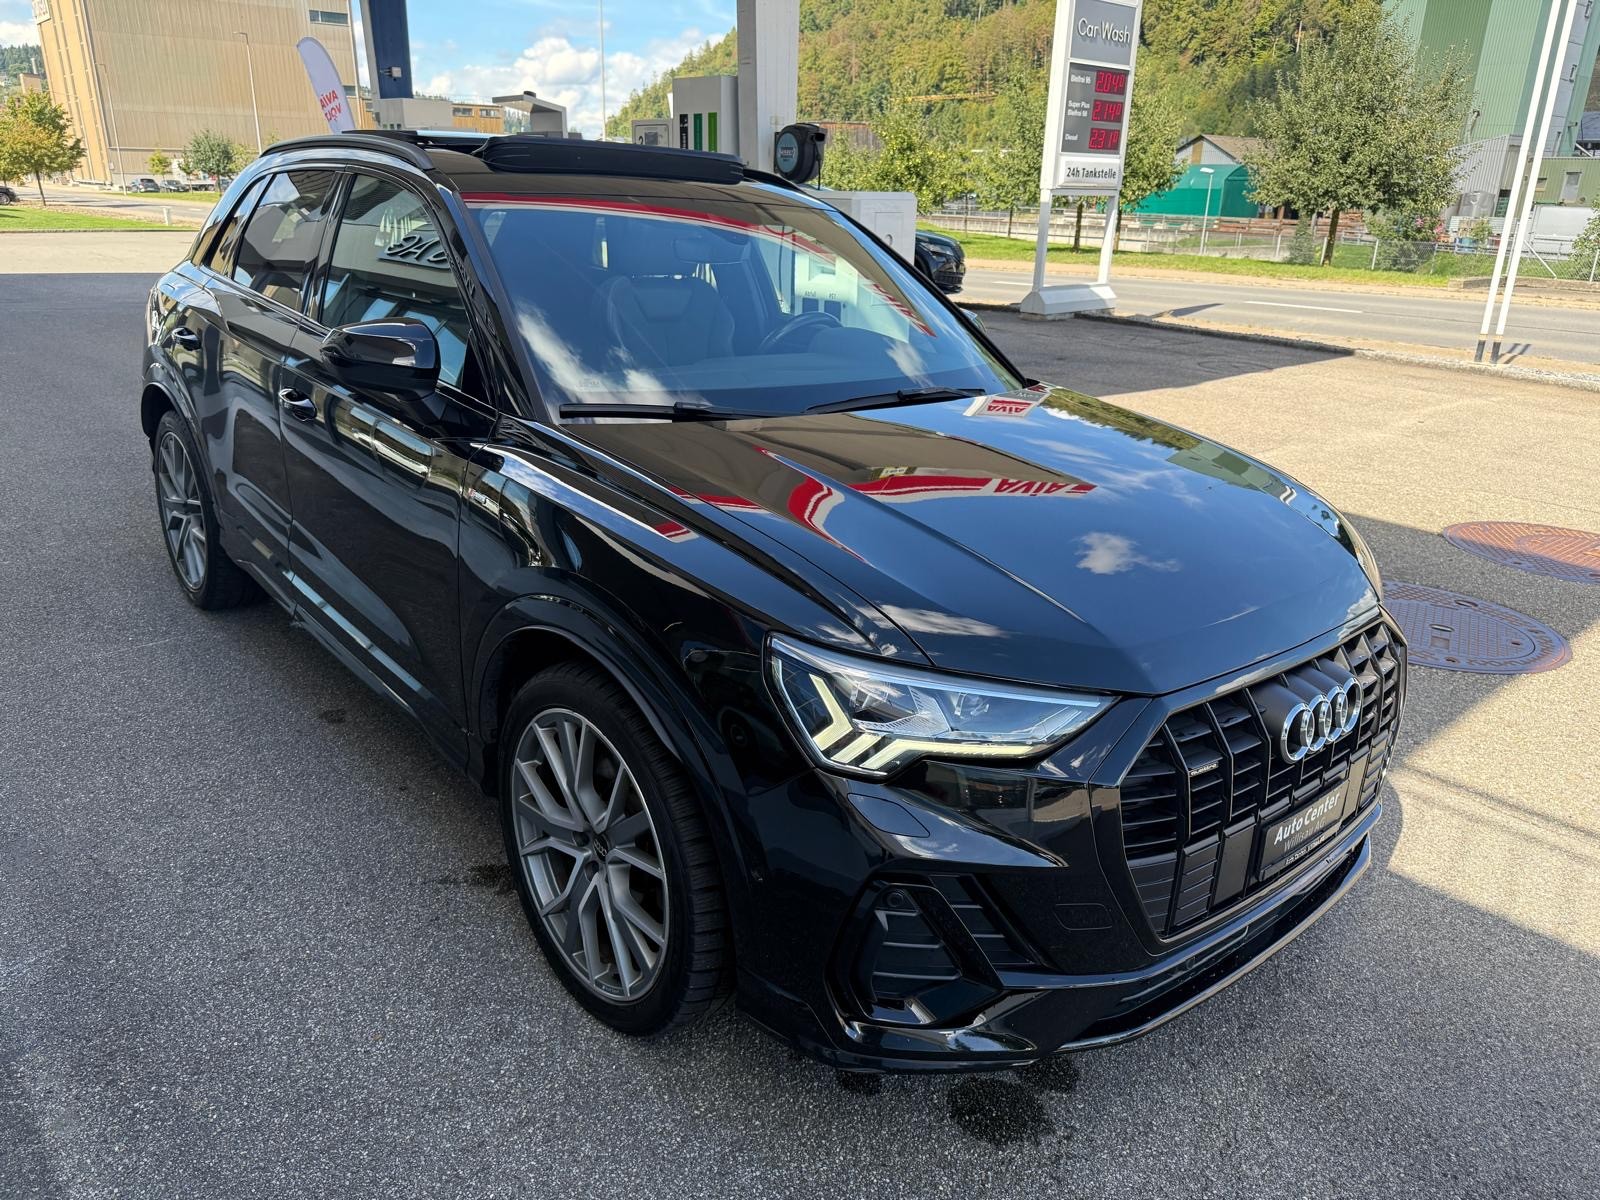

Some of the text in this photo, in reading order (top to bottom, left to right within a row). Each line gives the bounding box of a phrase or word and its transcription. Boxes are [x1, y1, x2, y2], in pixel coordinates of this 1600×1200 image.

[1078, 17, 1130, 43] Car Wash
[1068, 100, 1090, 109] Super Plus
[1065, 133, 1078, 141] Diesel
[1066, 167, 1116, 179] 24h Tankstelle
